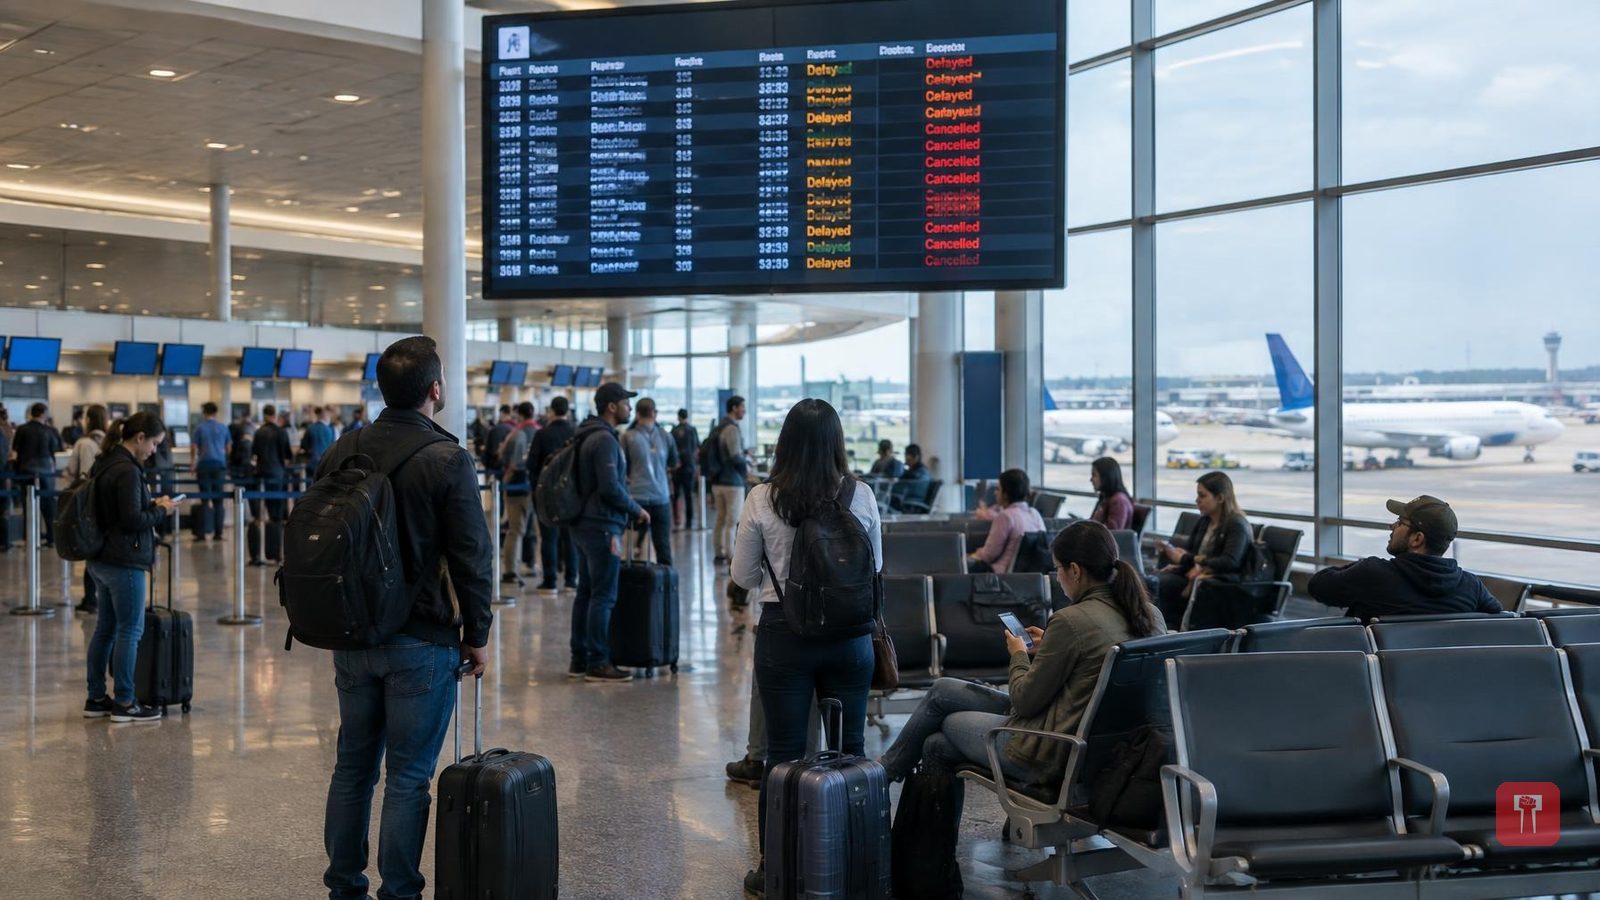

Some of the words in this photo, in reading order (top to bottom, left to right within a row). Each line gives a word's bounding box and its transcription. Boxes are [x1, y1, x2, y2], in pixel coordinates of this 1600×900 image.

[926, 56, 973, 70] Delayed
[806, 110, 852, 126] Delayed
[926, 122, 981, 135] Cancelled
[926, 138, 981, 152] Cancelled
[926, 154, 981, 168] Cancelled
[806, 176, 852, 190] Delayed
[926, 172, 981, 184] Cancelled
[806, 225, 852, 239] Delayed
[926, 221, 981, 234] Cancelled
[806, 241, 852, 254] Delayed
[926, 237, 981, 250] Cancelled
[806, 257, 852, 270] Delayed
[926, 254, 981, 266] Cancelled
